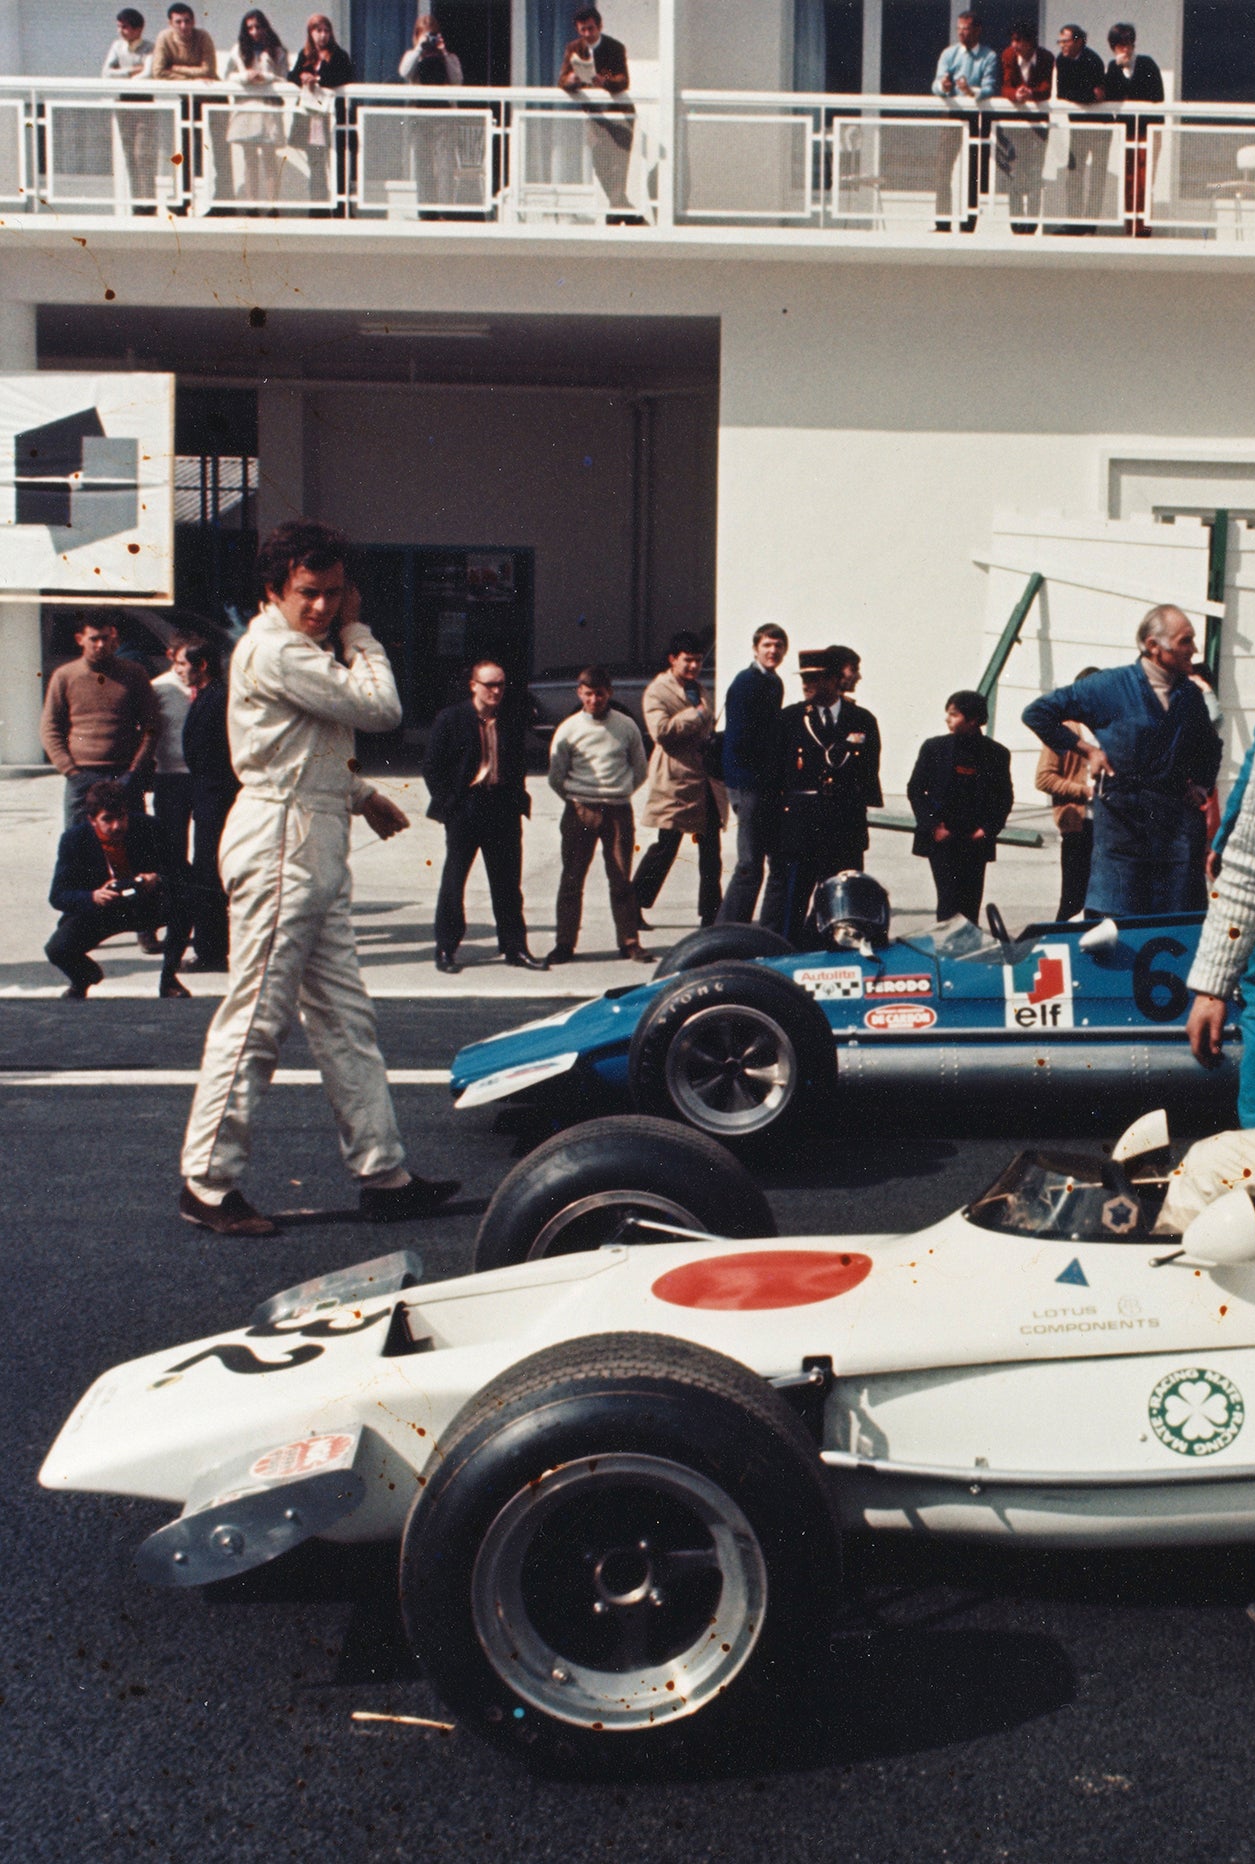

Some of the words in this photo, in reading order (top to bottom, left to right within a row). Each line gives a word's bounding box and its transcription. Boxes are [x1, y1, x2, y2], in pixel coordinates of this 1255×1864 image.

[801, 969, 856, 981] Autolite
[865, 979, 931, 993] FERODO
[1132, 935, 1189, 1022] 6
[1014, 1003, 1062, 1028] elf
[1032, 1305, 1097, 1319] LOTUS
[1019, 1317, 1160, 1335] COMPONENTS
[1150, 1369, 1199, 1408] RACING
[1204, 1370, 1242, 1404] MATE
[1151, 1416, 1189, 1453] MATE
[1193, 1411, 1243, 1456] RACING
